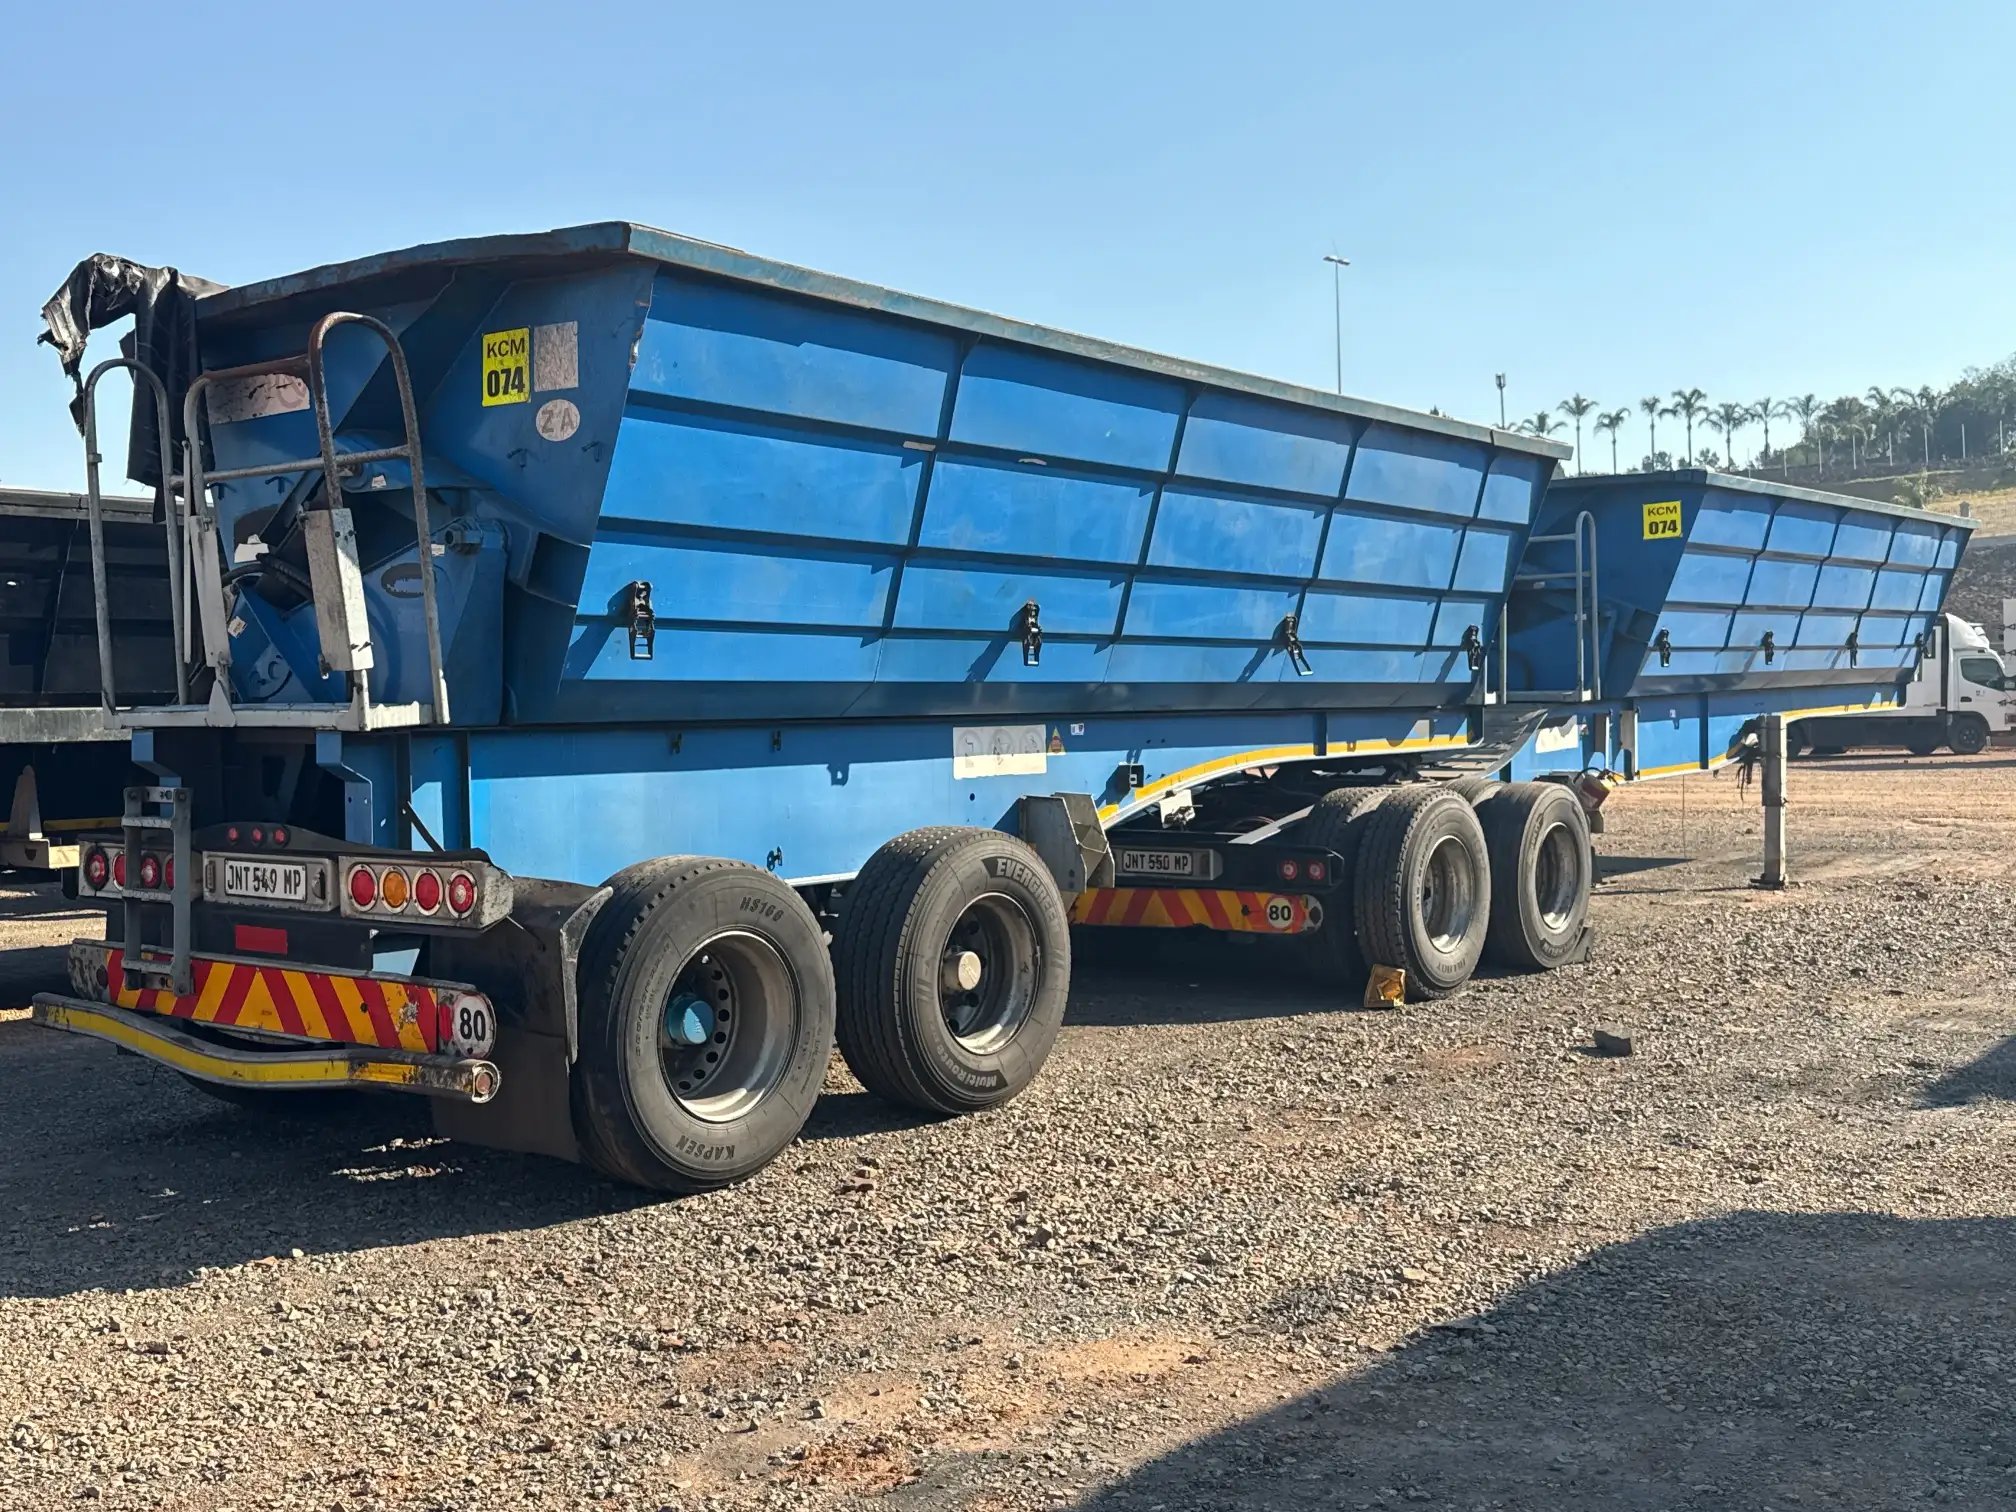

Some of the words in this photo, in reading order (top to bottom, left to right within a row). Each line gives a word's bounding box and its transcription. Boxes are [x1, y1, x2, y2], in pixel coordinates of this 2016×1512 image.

[486, 337, 526, 359] KCM
[486, 365, 526, 398] 074
[541, 407, 577, 434] ZA
[1647, 505, 1678, 516] KCM
[1648, 519, 1679, 535] 074
[1124, 853, 1146, 870] JNT
[1147, 853, 1171, 871] 550
[1174, 855, 1190, 872] MP
[227, 864, 251, 892] JNT
[252, 866, 278, 894] 549
[283, 868, 302, 896] MP
[1268, 904, 1292, 922] 80
[459, 1006, 487, 1042] 80
[675, 1134, 736, 1162] KAPSEN
